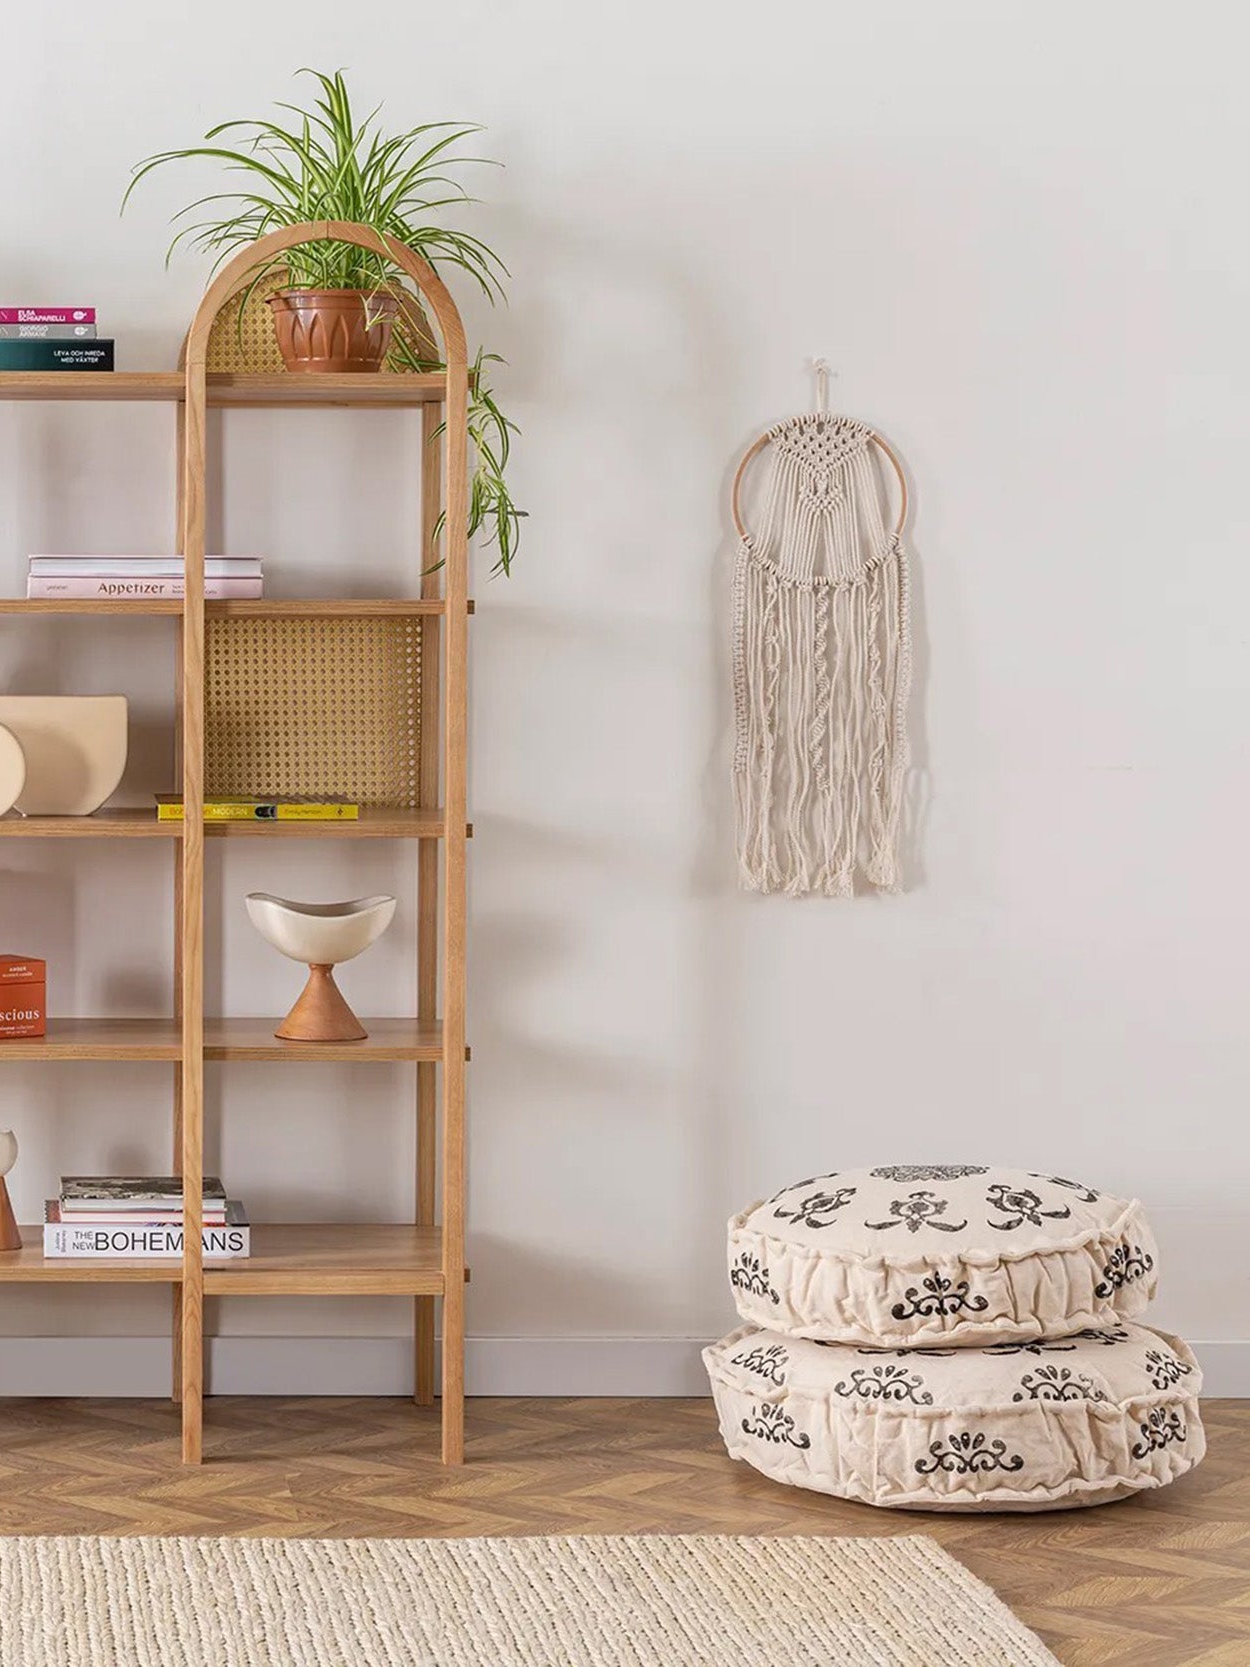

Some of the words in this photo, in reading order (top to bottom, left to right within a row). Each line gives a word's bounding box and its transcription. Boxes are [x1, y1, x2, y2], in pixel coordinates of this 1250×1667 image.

[97, 581, 166, 595] Appetizer
[74, 1231, 94, 1240] THE
[72, 1242, 96, 1251] NEW
[95, 1232, 244, 1251] BOHEMNS
